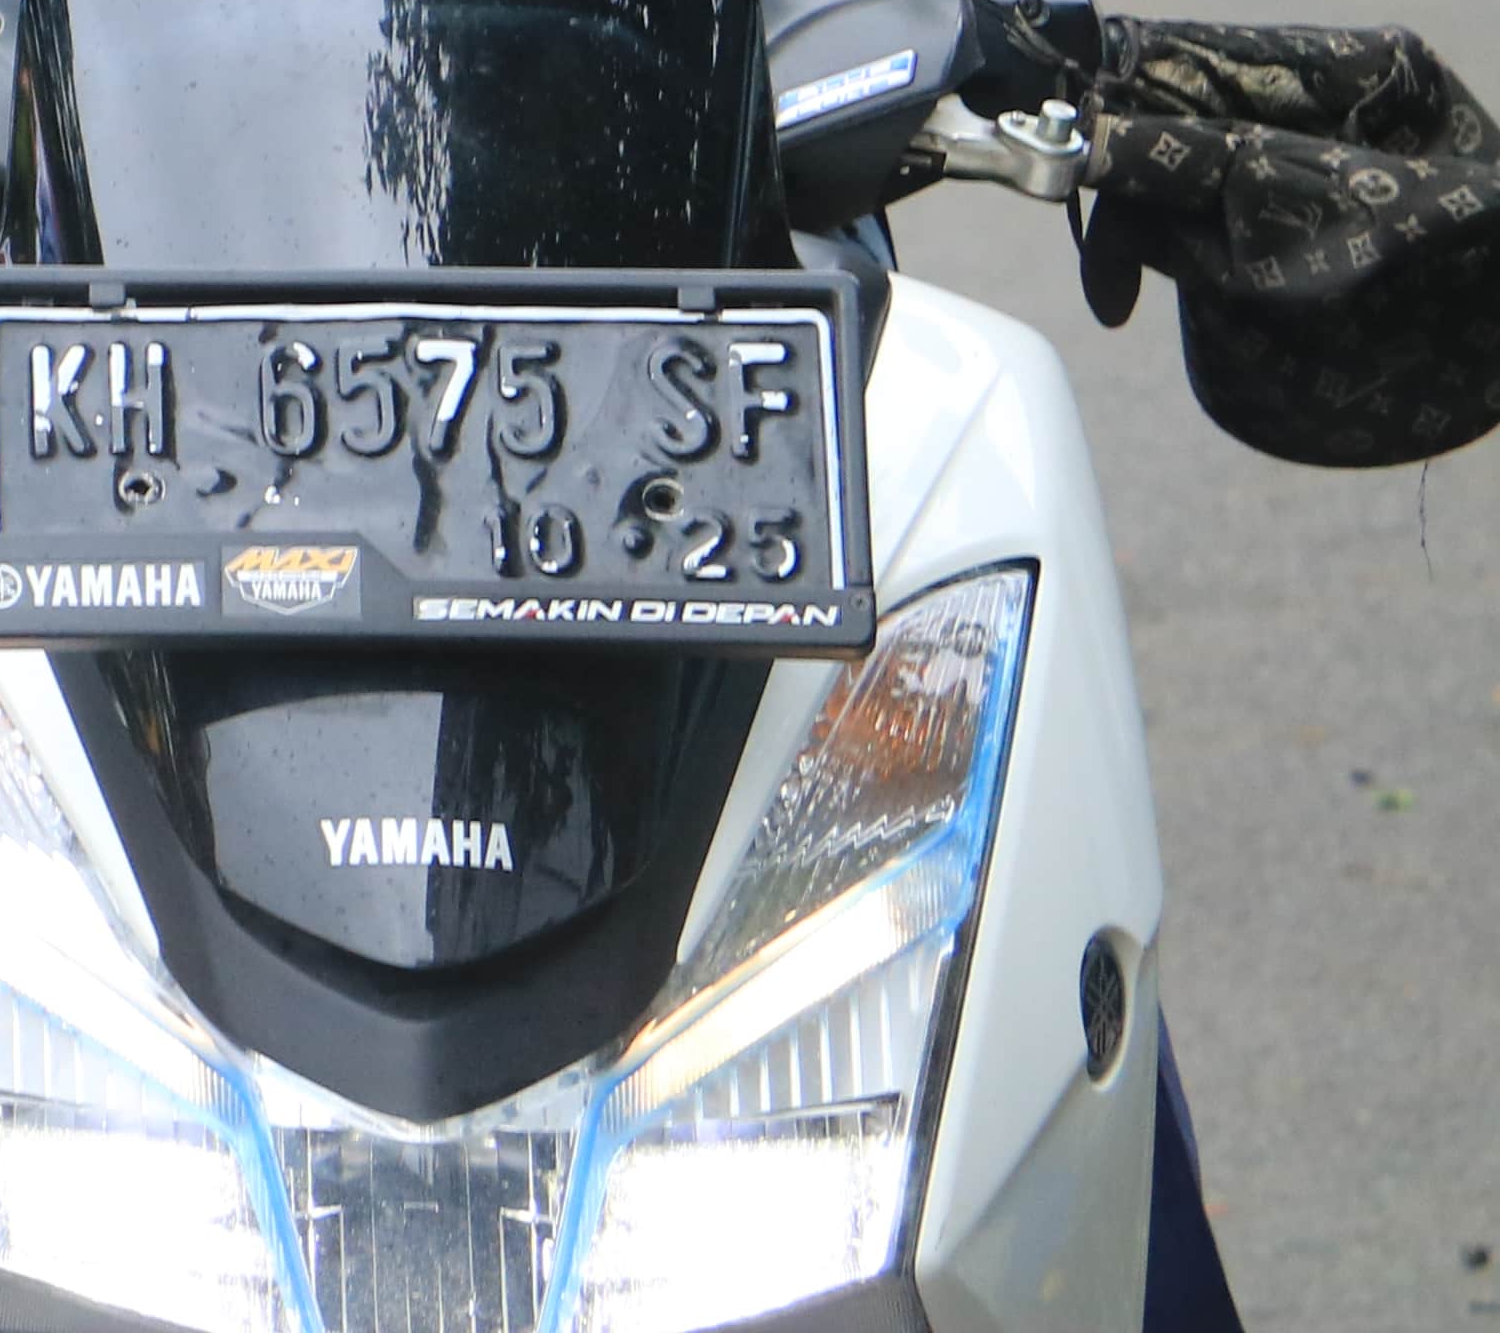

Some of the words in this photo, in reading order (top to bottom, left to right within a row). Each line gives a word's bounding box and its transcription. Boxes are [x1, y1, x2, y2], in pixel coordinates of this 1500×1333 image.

[28, 341, 178, 459] KH
[258, 338, 569, 460] 6575
[646, 339, 791, 460] SF
[225, 546, 356, 573] MAXI
[26, 564, 200, 607] YAMAHA
[251, 580, 322, 601] YAMAHA
[418, 597, 622, 622] SEMAKIN
[681, 601, 841, 627] DEPAN
[320, 817, 514, 872] YAMAHA
